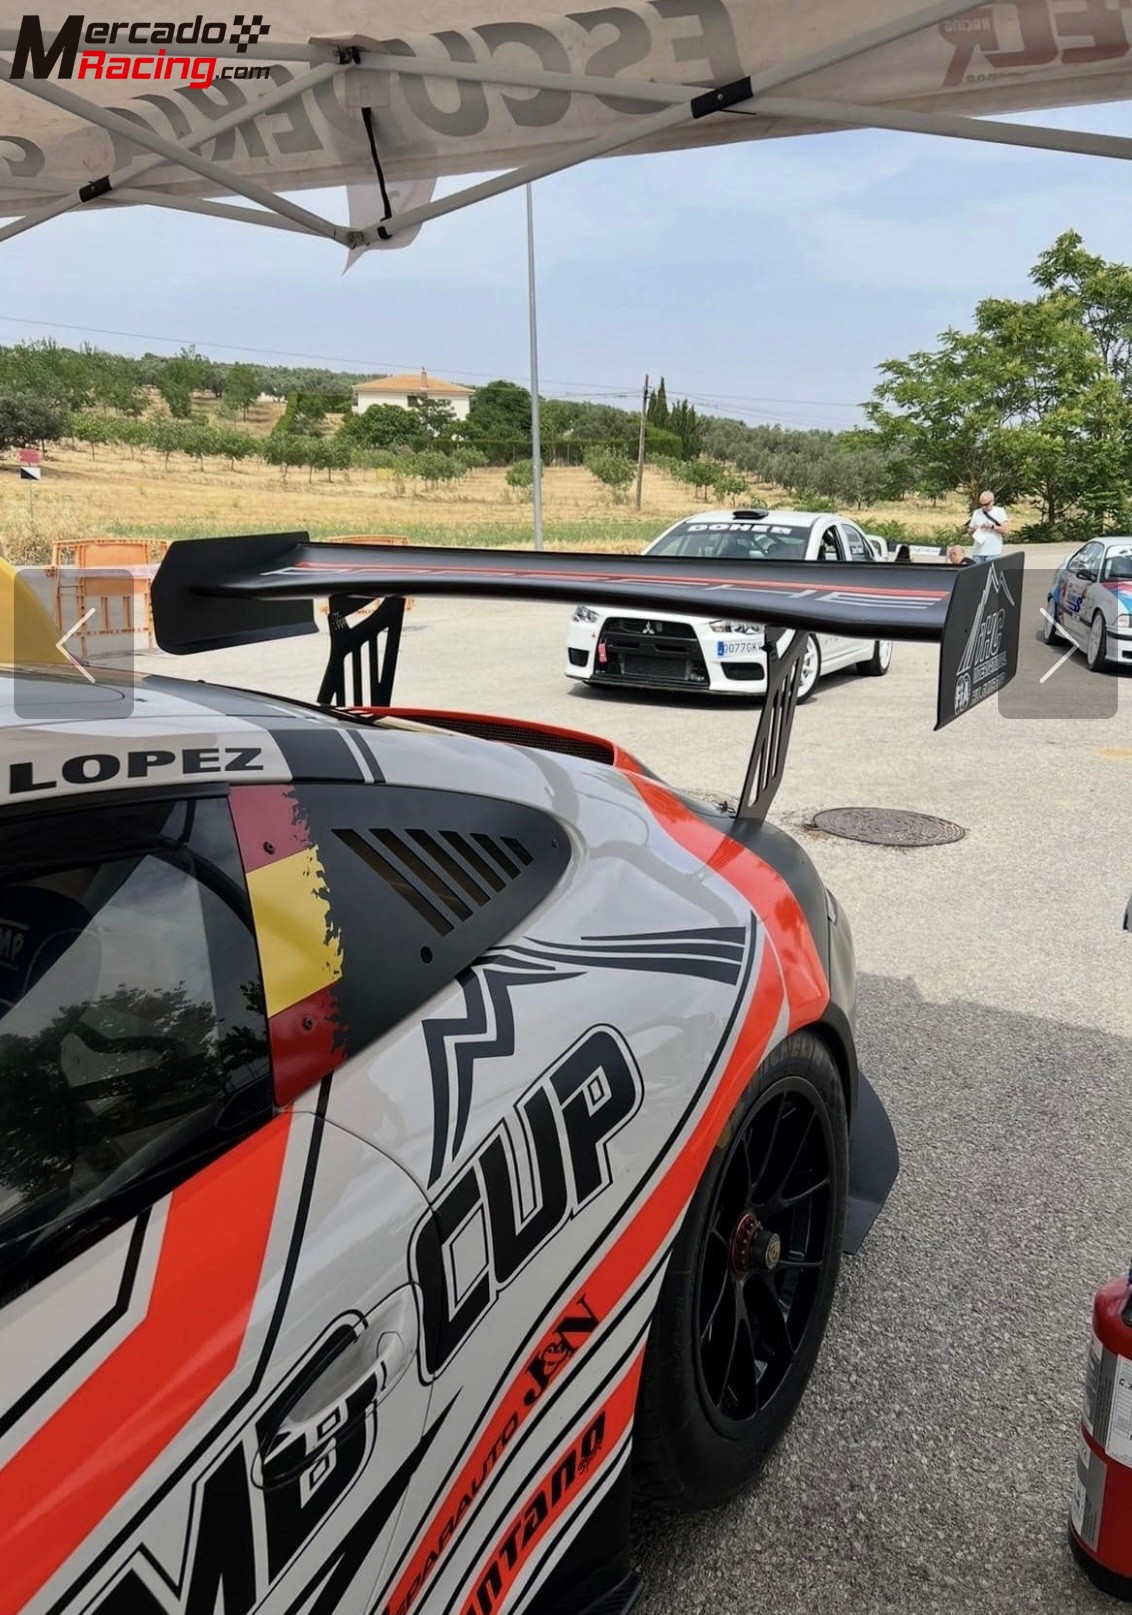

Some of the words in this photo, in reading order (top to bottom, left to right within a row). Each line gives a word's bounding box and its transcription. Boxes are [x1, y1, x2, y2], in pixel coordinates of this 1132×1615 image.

[9, 747, 264, 794] LOPEZ
[408, 1023, 645, 1386] CUP
[523, 1292, 600, 1407] J&N
